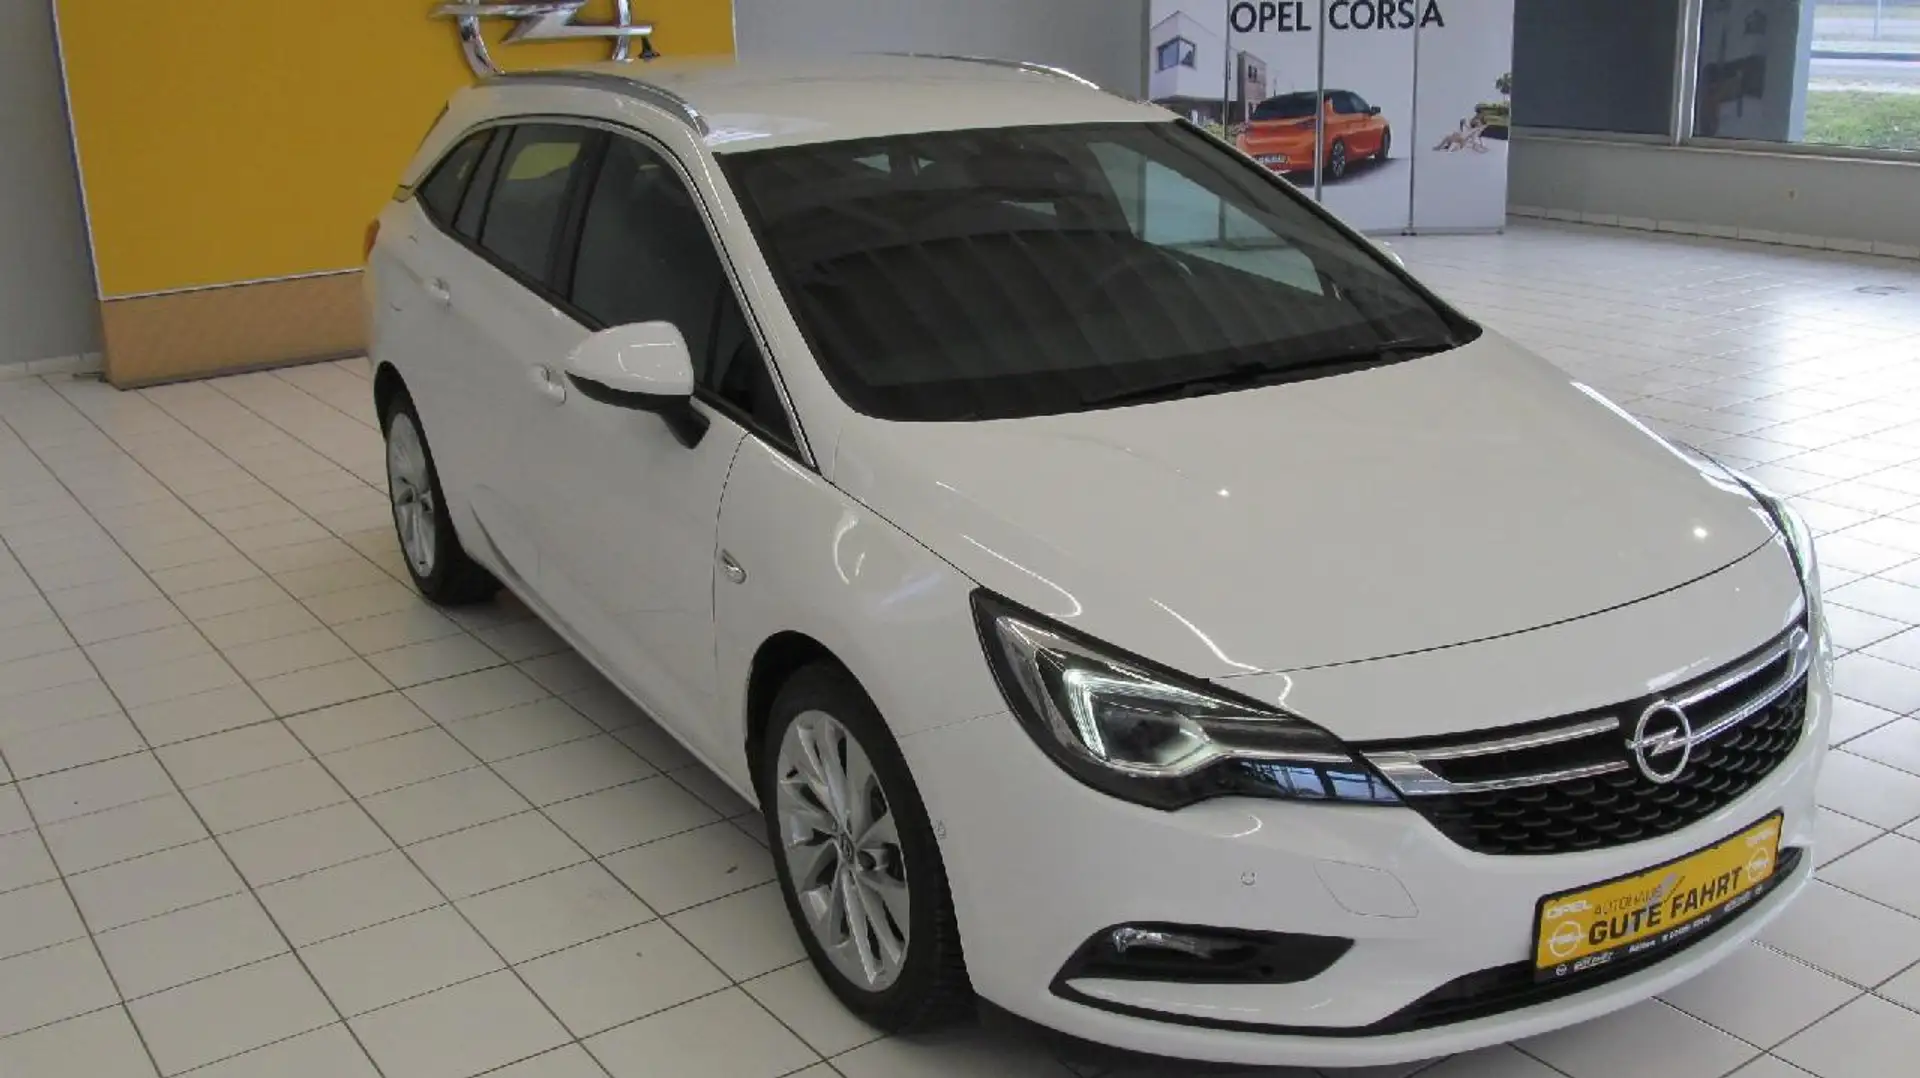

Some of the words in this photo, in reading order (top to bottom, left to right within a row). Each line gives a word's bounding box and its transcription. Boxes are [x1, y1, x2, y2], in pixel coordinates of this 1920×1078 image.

[1230, 0, 1312, 33] OPEL
[1328, 0, 1445, 30] CORSA
[1588, 902, 1663, 945] GUTE
[1670, 866, 1743, 919] FAHRT
